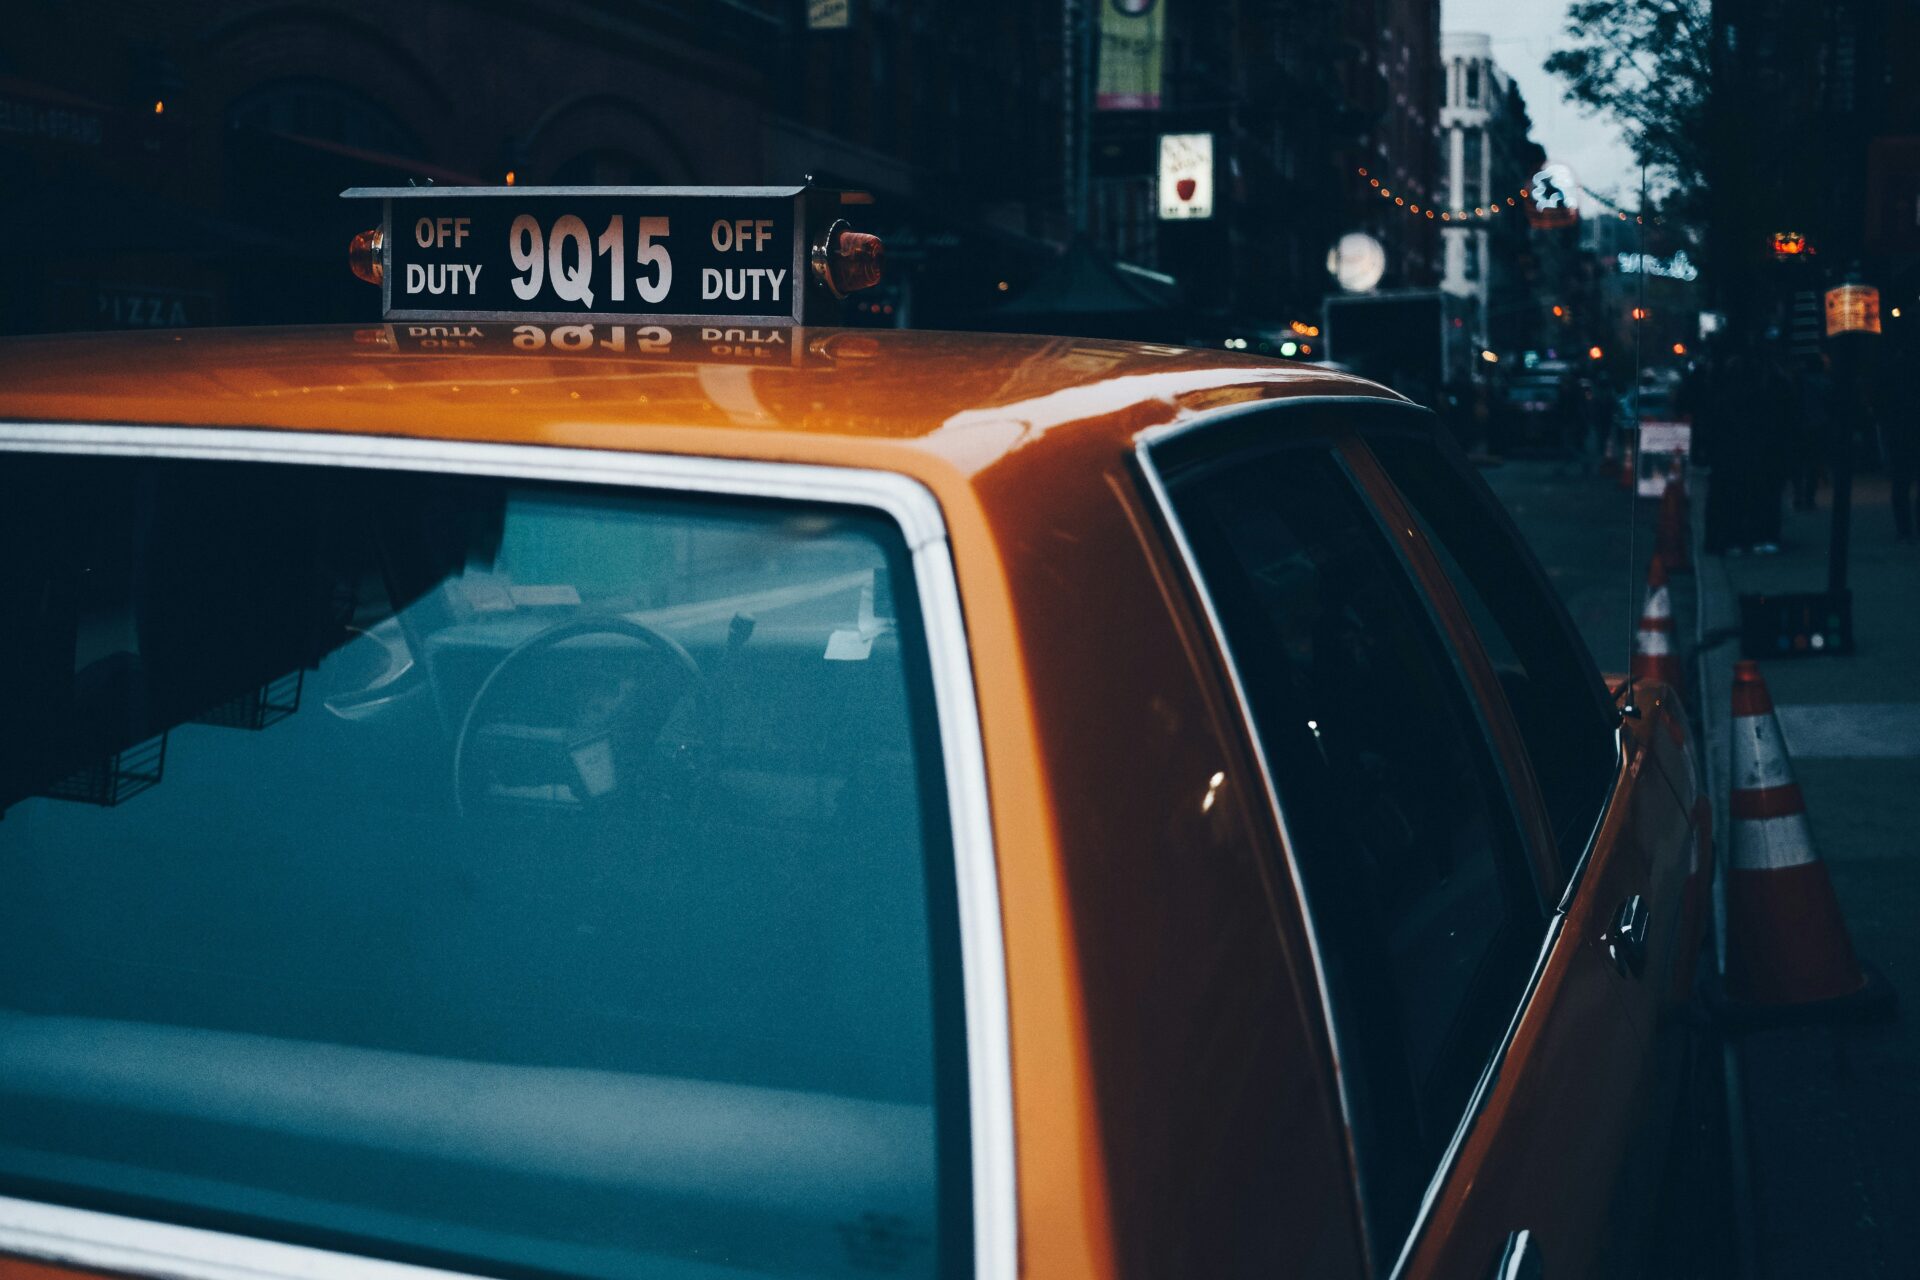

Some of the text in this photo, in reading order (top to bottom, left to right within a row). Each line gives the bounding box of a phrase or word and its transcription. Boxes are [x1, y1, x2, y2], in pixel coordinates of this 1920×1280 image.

[415, 217, 471, 248] OFF
[711, 219, 773, 252] OFF
[509, 214, 672, 309] 9Q15
[406, 263, 482, 295] DUTY
[702, 268, 786, 301] DUTY
